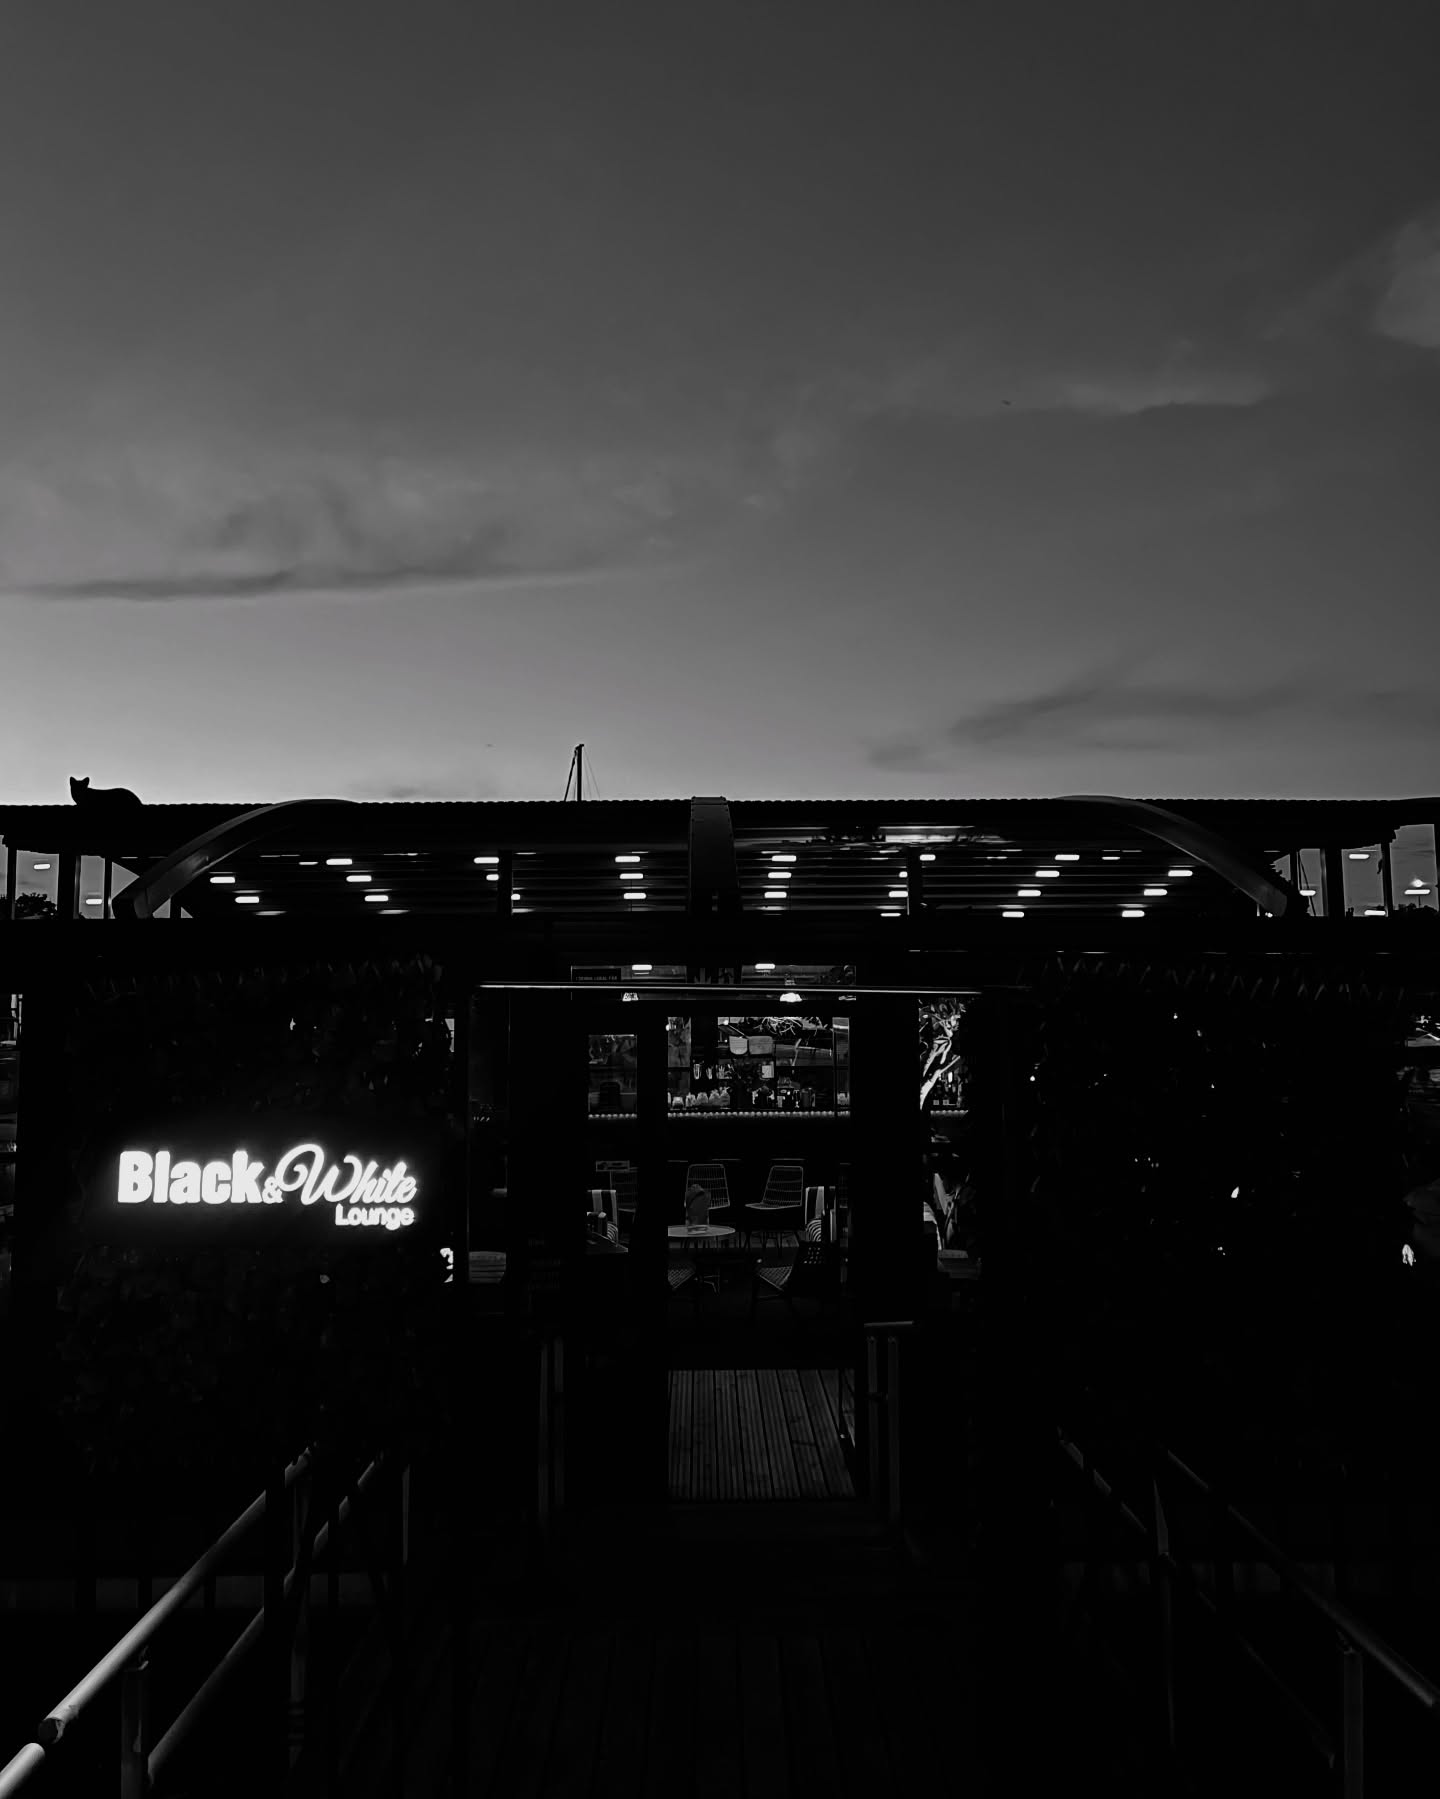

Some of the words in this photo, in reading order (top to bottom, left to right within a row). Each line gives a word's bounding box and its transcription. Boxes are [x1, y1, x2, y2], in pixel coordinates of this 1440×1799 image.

[118, 1150, 264, 1204] Black
[262, 1176, 284, 1204] &
[275, 1144, 417, 1205] White
[335, 1203, 415, 1230] Lounge
